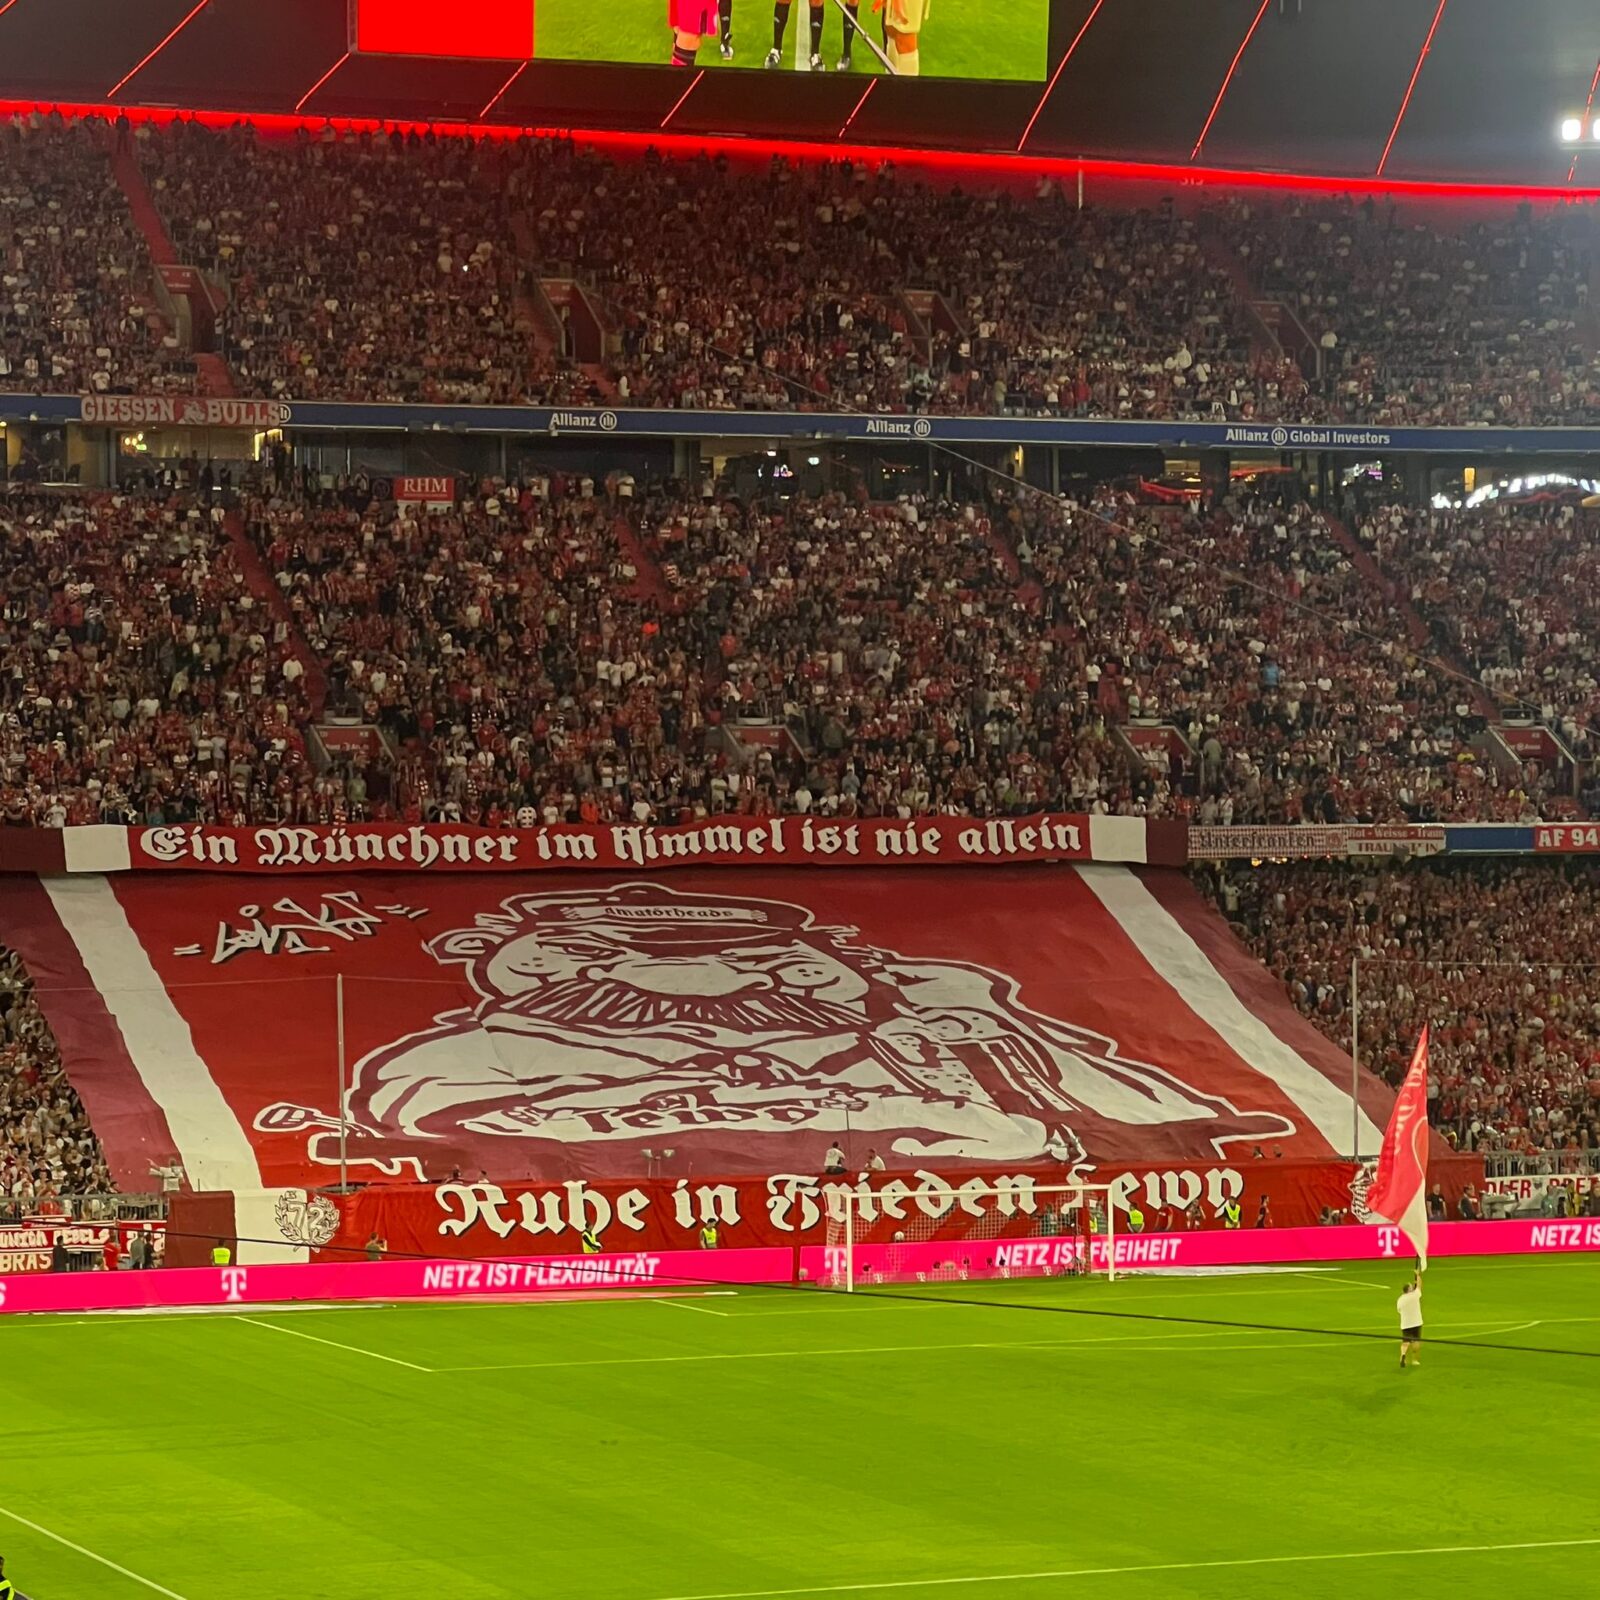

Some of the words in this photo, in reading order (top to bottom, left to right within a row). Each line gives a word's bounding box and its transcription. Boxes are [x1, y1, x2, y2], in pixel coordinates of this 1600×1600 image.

[81, 397, 175, 422] GIESSEN
[207, 401, 280, 426] BULLS
[550, 412, 597, 427] Allianz
[866, 420, 911, 435] Allianz
[1225, 428, 1269, 442] Allianz
[1289, 430, 1330, 444] Global
[1332, 431, 1391, 445] Investors
[404, 478, 447, 493] RHM
[140, 826, 237, 863] Ein
[257, 827, 518, 867] Münchner
[536, 828, 597, 858] im
[800, 818, 859, 855] ist
[874, 823, 940, 855] nie
[958, 817, 1082, 855] allein
[1358, 842, 1440, 852] TRAUTIN
[1538, 829, 1566, 847] AF
[1571, 828, 1599, 847] 94
[435, 1179, 650, 1238] Ruhe
[672, 1178, 742, 1229] in
[1530, 1224, 1582, 1247] NETZ
[997, 1243, 1050, 1267] NETZ
[1052, 1243, 1086, 1264] IST
[1090, 1239, 1181, 1262] FREIHEIT
[423, 1265, 480, 1288] NETZ
[486, 1263, 523, 1286] IST
[525, 1253, 660, 1286] FLEXIBILITÄT
